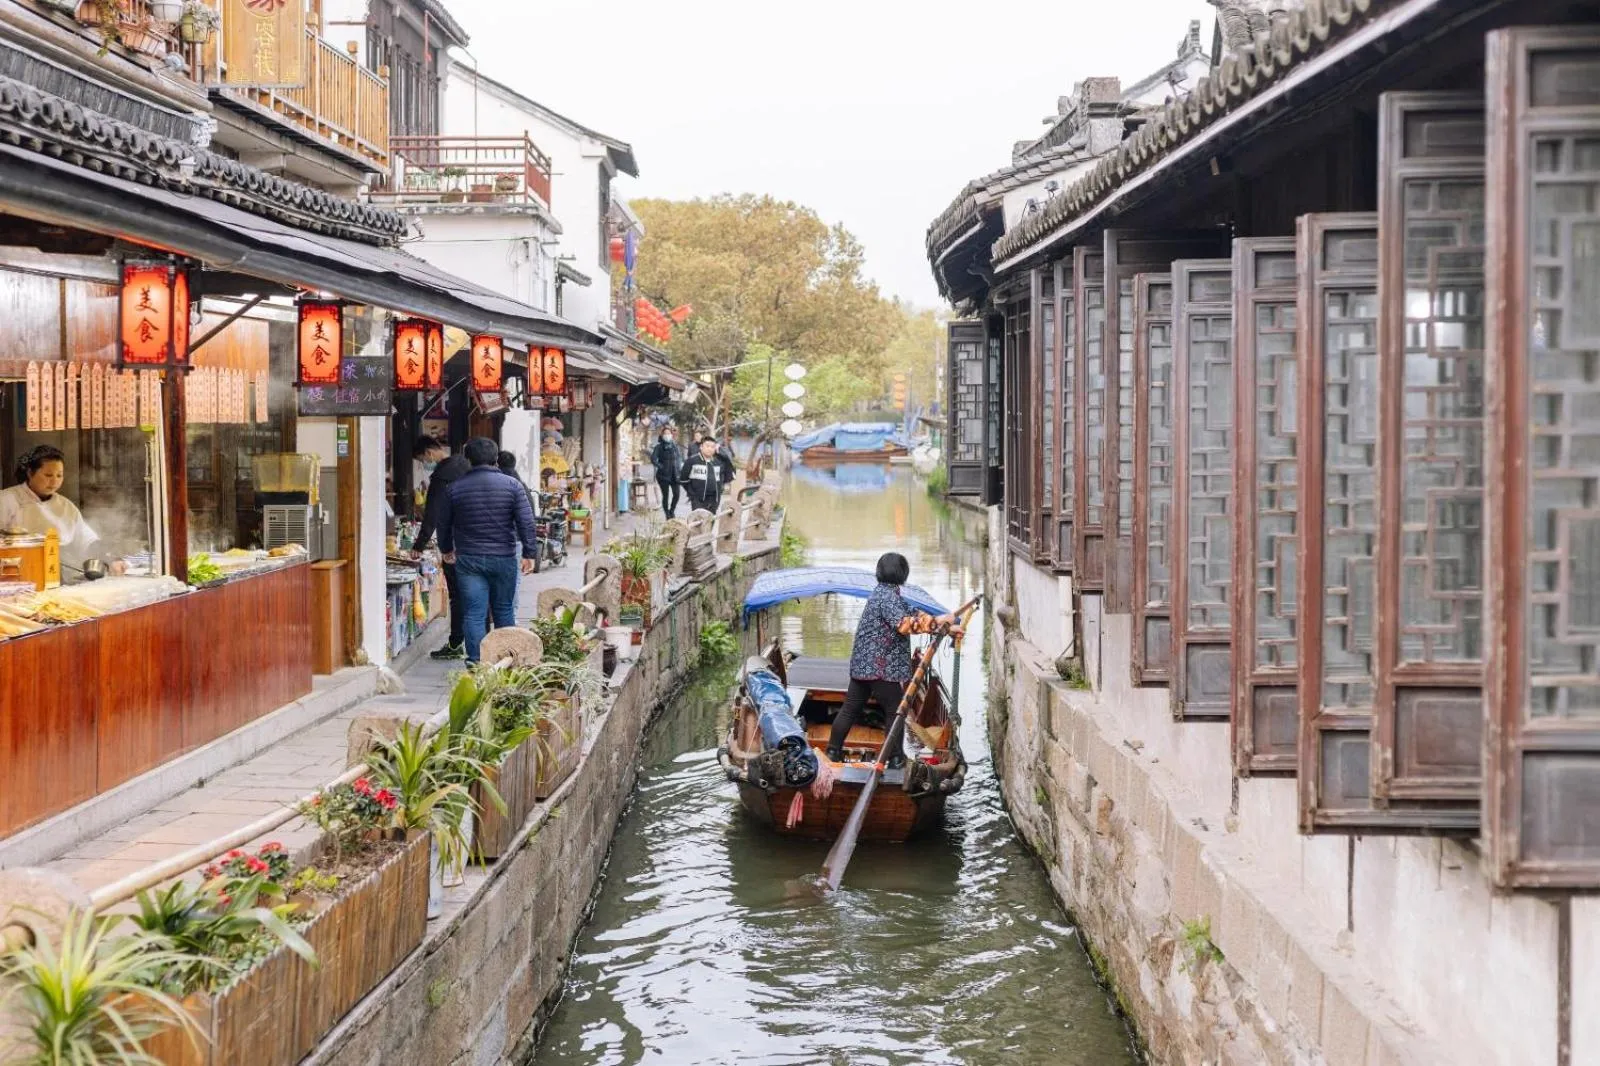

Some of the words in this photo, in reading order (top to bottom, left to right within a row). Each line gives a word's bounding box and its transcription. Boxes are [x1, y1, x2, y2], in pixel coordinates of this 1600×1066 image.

[132, 287, 159, 343] 美食
[311, 321, 331, 365] 美食
[405, 338, 419, 375] 美食
[429, 337, 438, 375] 美食
[481, 347, 496, 379] 美食
[549, 356, 559, 384] 美食
